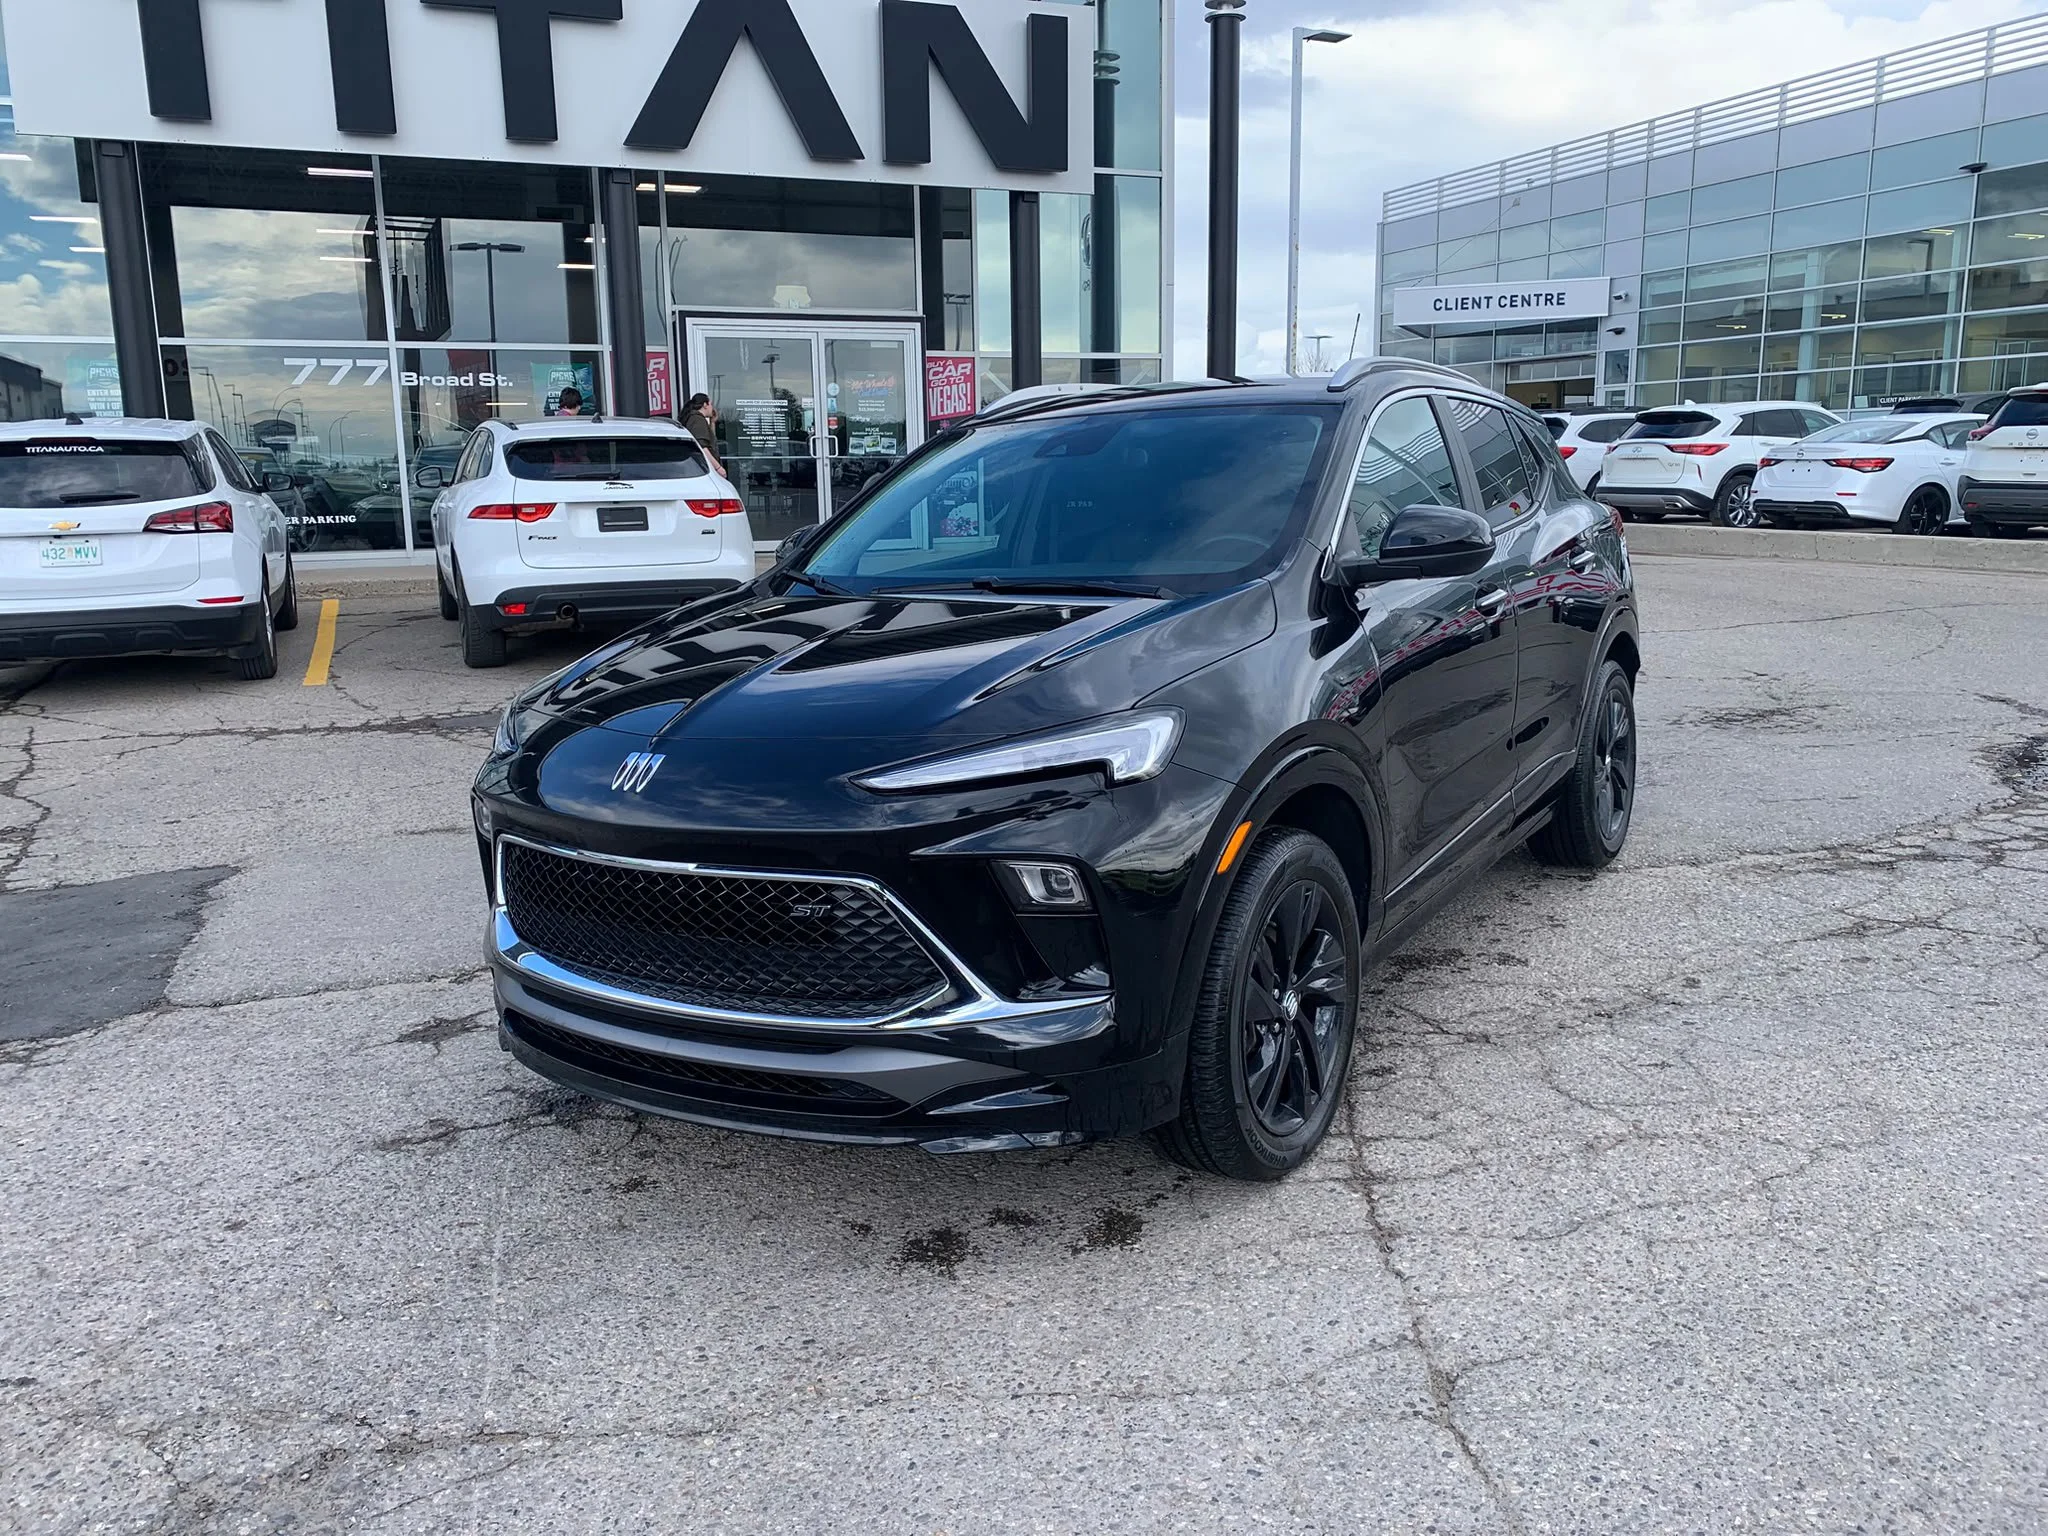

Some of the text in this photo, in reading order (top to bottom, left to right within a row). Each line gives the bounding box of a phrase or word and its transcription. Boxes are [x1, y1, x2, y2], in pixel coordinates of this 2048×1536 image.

[1433, 292, 1566, 311] CLIENT CENTRE
[283, 358, 514, 387] 777 Broad St.
[929, 363, 972, 380] CAR
[931, 376, 964, 387] GO TO
[929, 382, 971, 417] VEGAS!
[302, 515, 357, 525] PARKING
[42, 546, 97, 560] 432 MVV
[790, 904, 832, 918] ST
